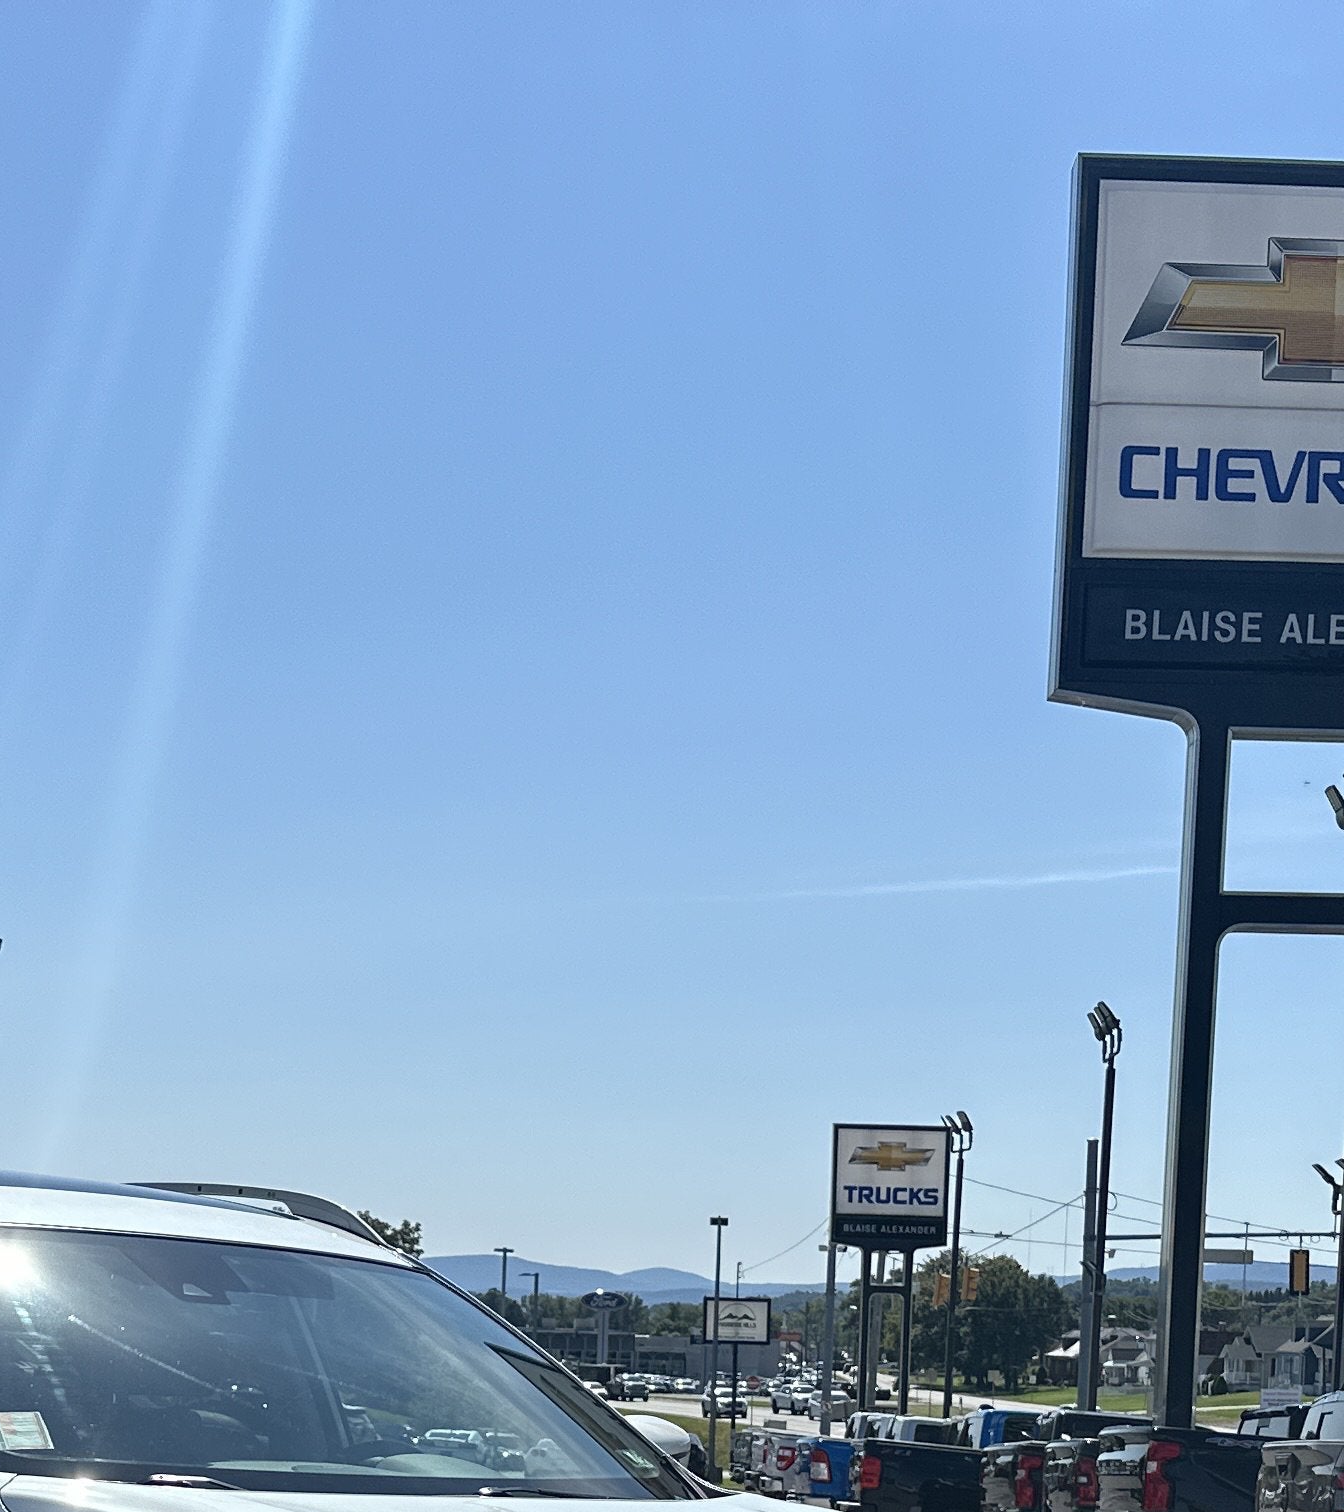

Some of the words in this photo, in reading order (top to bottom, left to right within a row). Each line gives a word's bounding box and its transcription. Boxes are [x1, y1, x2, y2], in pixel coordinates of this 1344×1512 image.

[1124, 609, 1263, 643] BLAISE
[843, 1186, 939, 1205] TRUCKS
[843, 1223, 876, 1233] BLAISE
[880, 1225, 936, 1234] ALEXANDER
